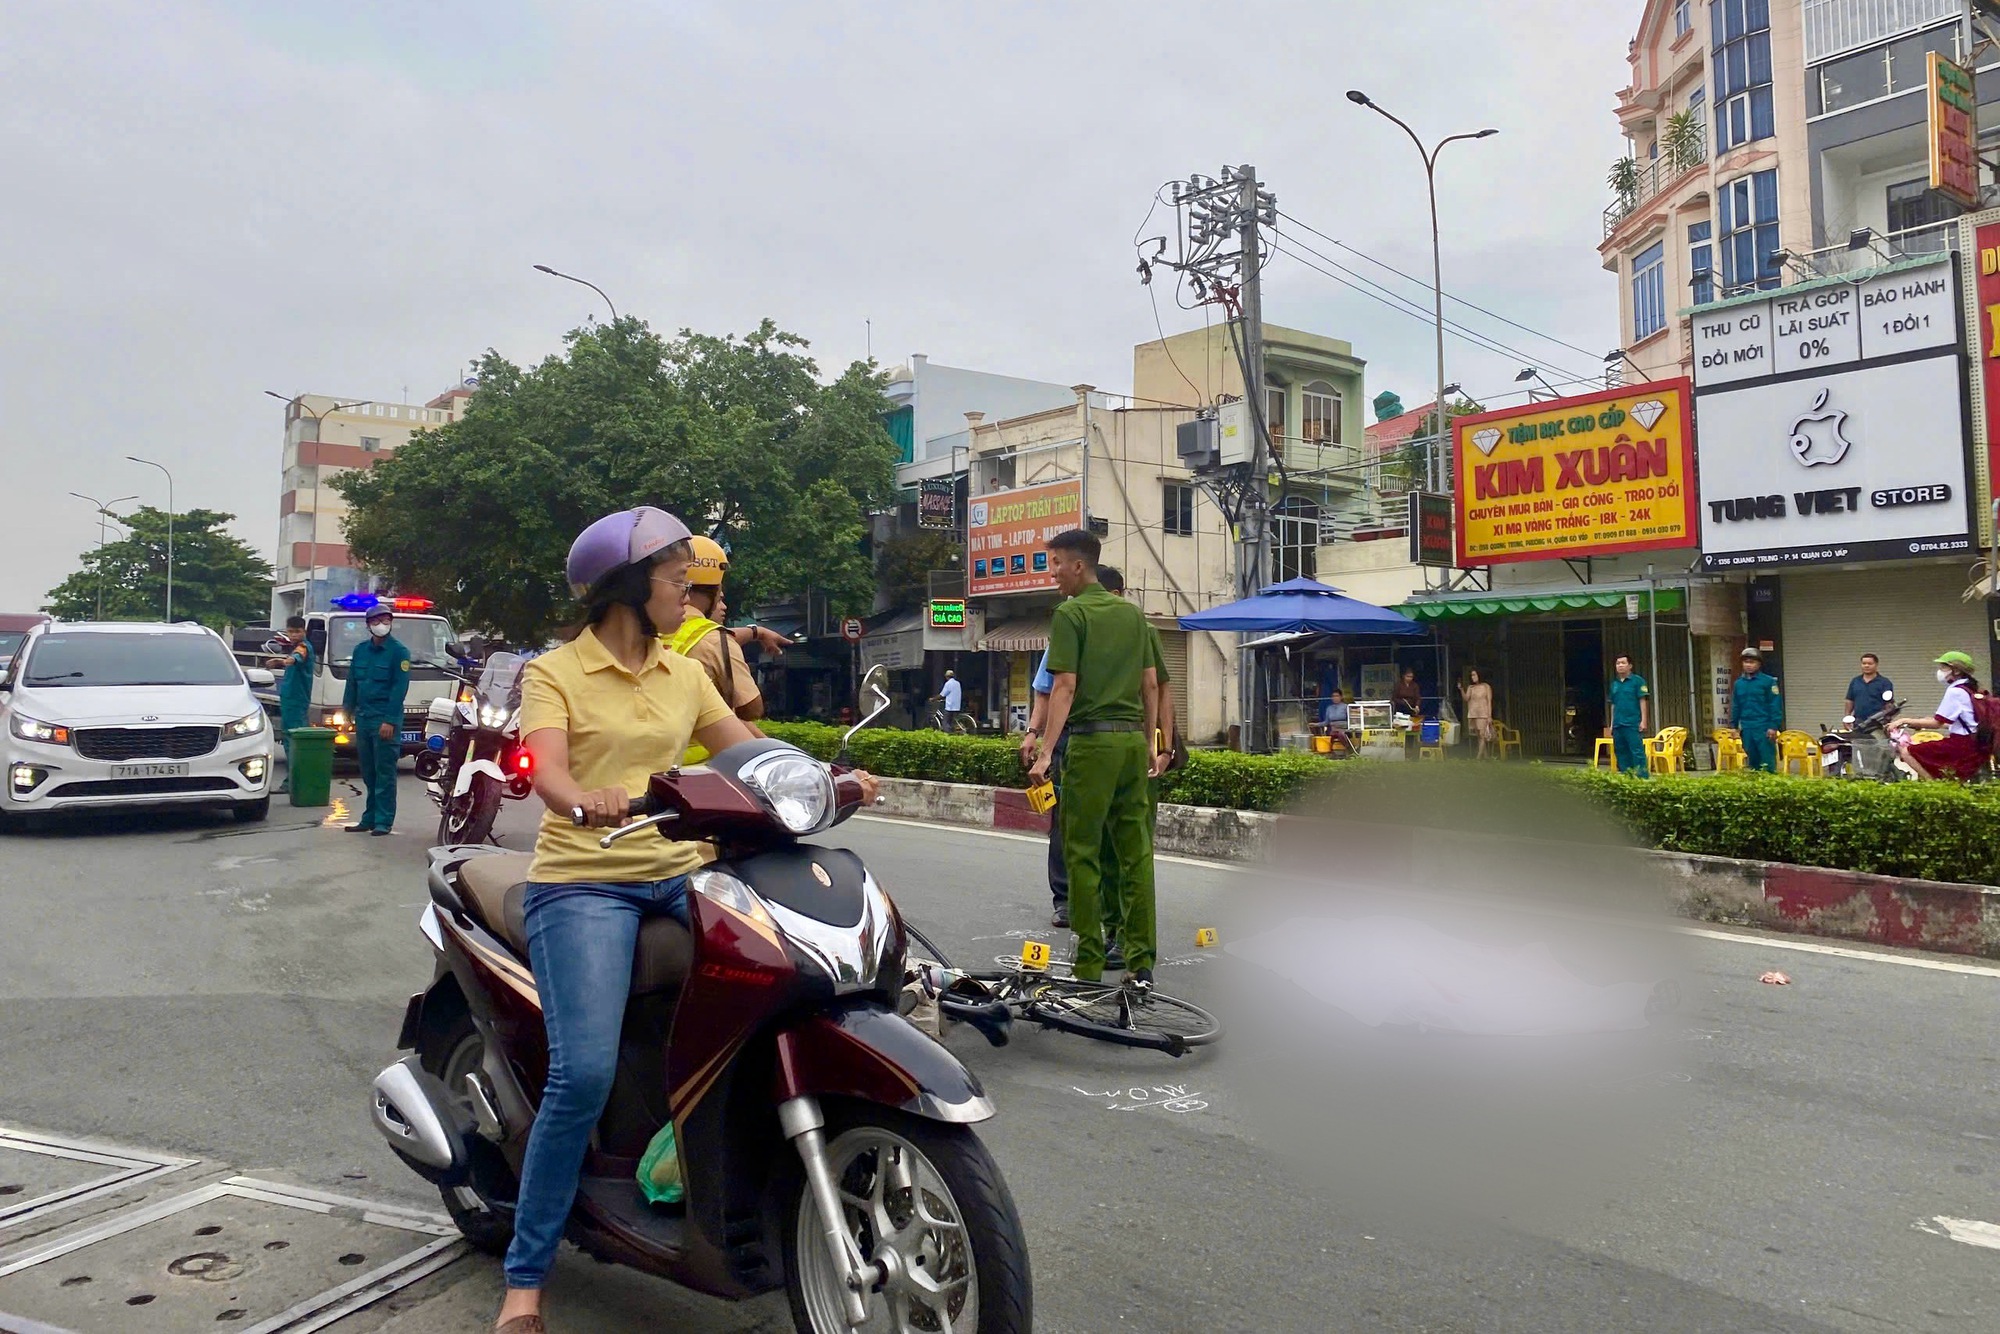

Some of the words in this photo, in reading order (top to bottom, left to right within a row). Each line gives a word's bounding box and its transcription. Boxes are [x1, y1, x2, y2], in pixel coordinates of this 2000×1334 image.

[1981, 245, 2000, 275] D
[1815, 289, 1850, 308] GÓP
[1863, 288, 1897, 308] BẢO
[1901, 278, 1945, 301] HÀNH
[1701, 321, 1731, 339] THU
[1739, 314, 1761, 331] CŨ
[1778, 319, 1803, 337] LÃI
[1808, 310, 1850, 331] SUẤT
[1883, 322, 1890, 335] 1
[1923, 315, 1930, 328] 1
[1734, 345, 1764, 363] MỚI
[1799, 338, 1830, 360] 0%
[1539, 419, 1565, 441] BẠC
[1567, 414, 1596, 434] CAO
[1598, 403, 1626, 430] CẤP
[1474, 456, 1545, 501] KIM
[1554, 433, 1668, 490] XUÂN
[923, 483, 949, 494] LUXURY
[1469, 504, 1506, 521] CHUYÊN
[1508, 502, 1530, 517] MUA
[1533, 498, 1554, 514] BÁN
[1562, 497, 1580, 510] GIA
[1583, 491, 1614, 508] CÔNG
[1625, 487, 1655, 502] TRAO
[1658, 479, 1680, 499] ĐỔI
[1707, 494, 1787, 524] TUNG
[1793, 486, 1862, 516] VIET
[1875, 485, 1946, 507] STORE
[990, 503, 1025, 525] LAPTOP
[1493, 524, 1503, 537] XI
[1506, 522, 1522, 537] MẠ
[1524, 518, 1552, 533] VÀNG
[1555, 511, 1590, 530] TRẮNG
[1600, 511, 1618, 525] 18K
[1629, 507, 1651, 522] 24K
[971, 533, 986, 552] MÁY
[1009, 529, 1036, 547] LAPTOP
[1603, 530, 1618, 539] 0909
[1641, 526, 1656, 535] 0934
[1657, 526, 1669, 534] 030
[1669, 524, 1681, 533] 979
[1733, 556, 1755, 565] QUANG
[1757, 554, 1779, 563] TRUNG
[1784, 553, 1791, 561] P.
[1800, 551, 1820, 561] QUẬN
[1821, 549, 1833, 558] GÒ
[1834, 547, 1849, 557] VẤP
[933, 612, 947, 623] GIÁ
[947, 614, 963, 623] CAO
[1044, 792, 1054, 802] 4
[1205, 930, 1214, 942] 2
[1030, 945, 1042, 960] 3
